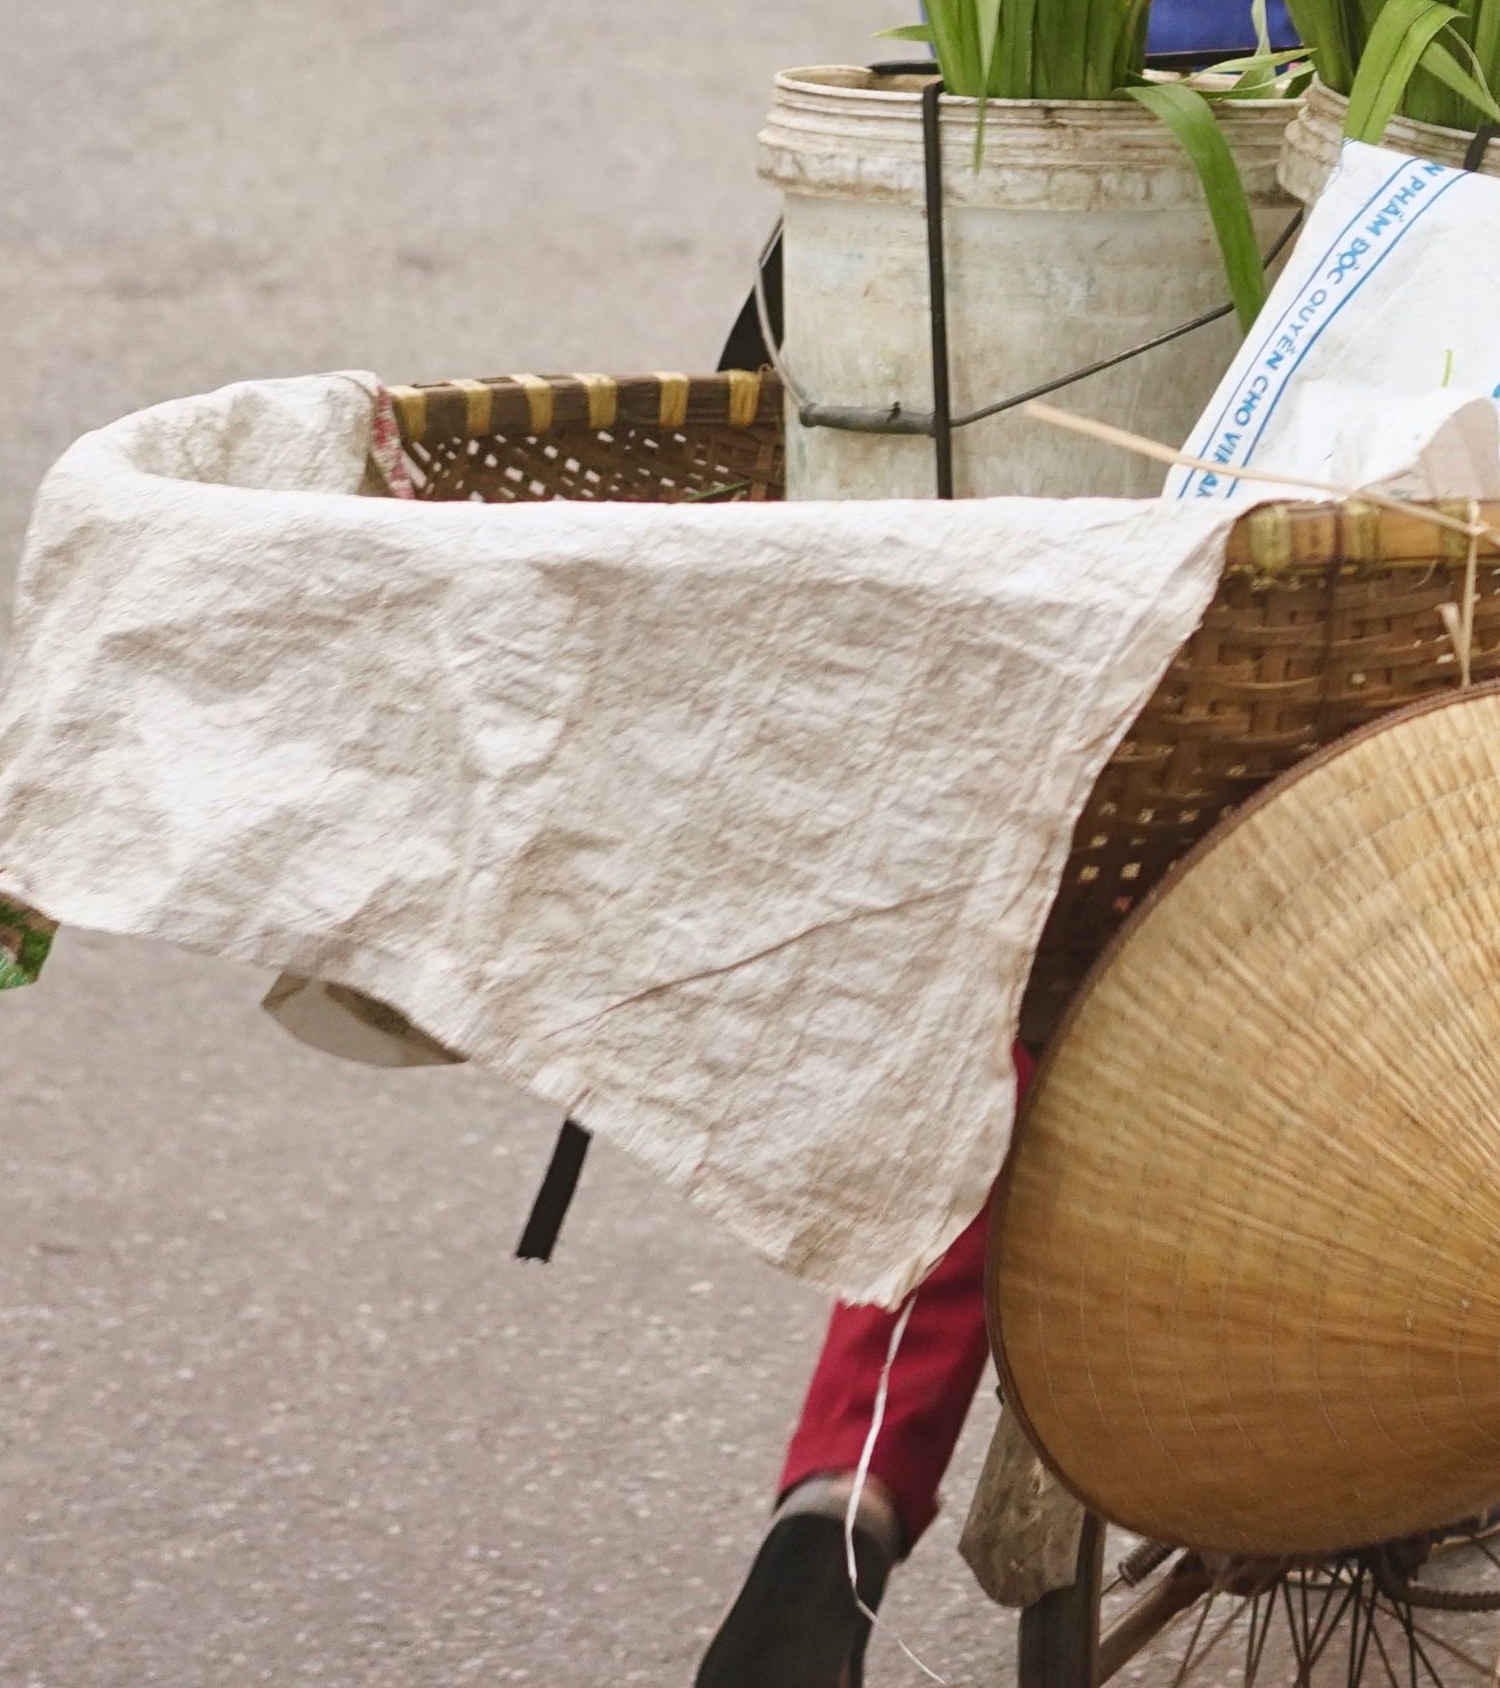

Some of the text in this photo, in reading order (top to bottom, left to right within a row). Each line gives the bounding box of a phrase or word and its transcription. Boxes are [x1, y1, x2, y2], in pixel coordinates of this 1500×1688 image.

[1326, 237, 1371, 285] ĐỘC
[1266, 288, 1327, 370] QUYỀN
[1235, 375, 1268, 426] CHO
